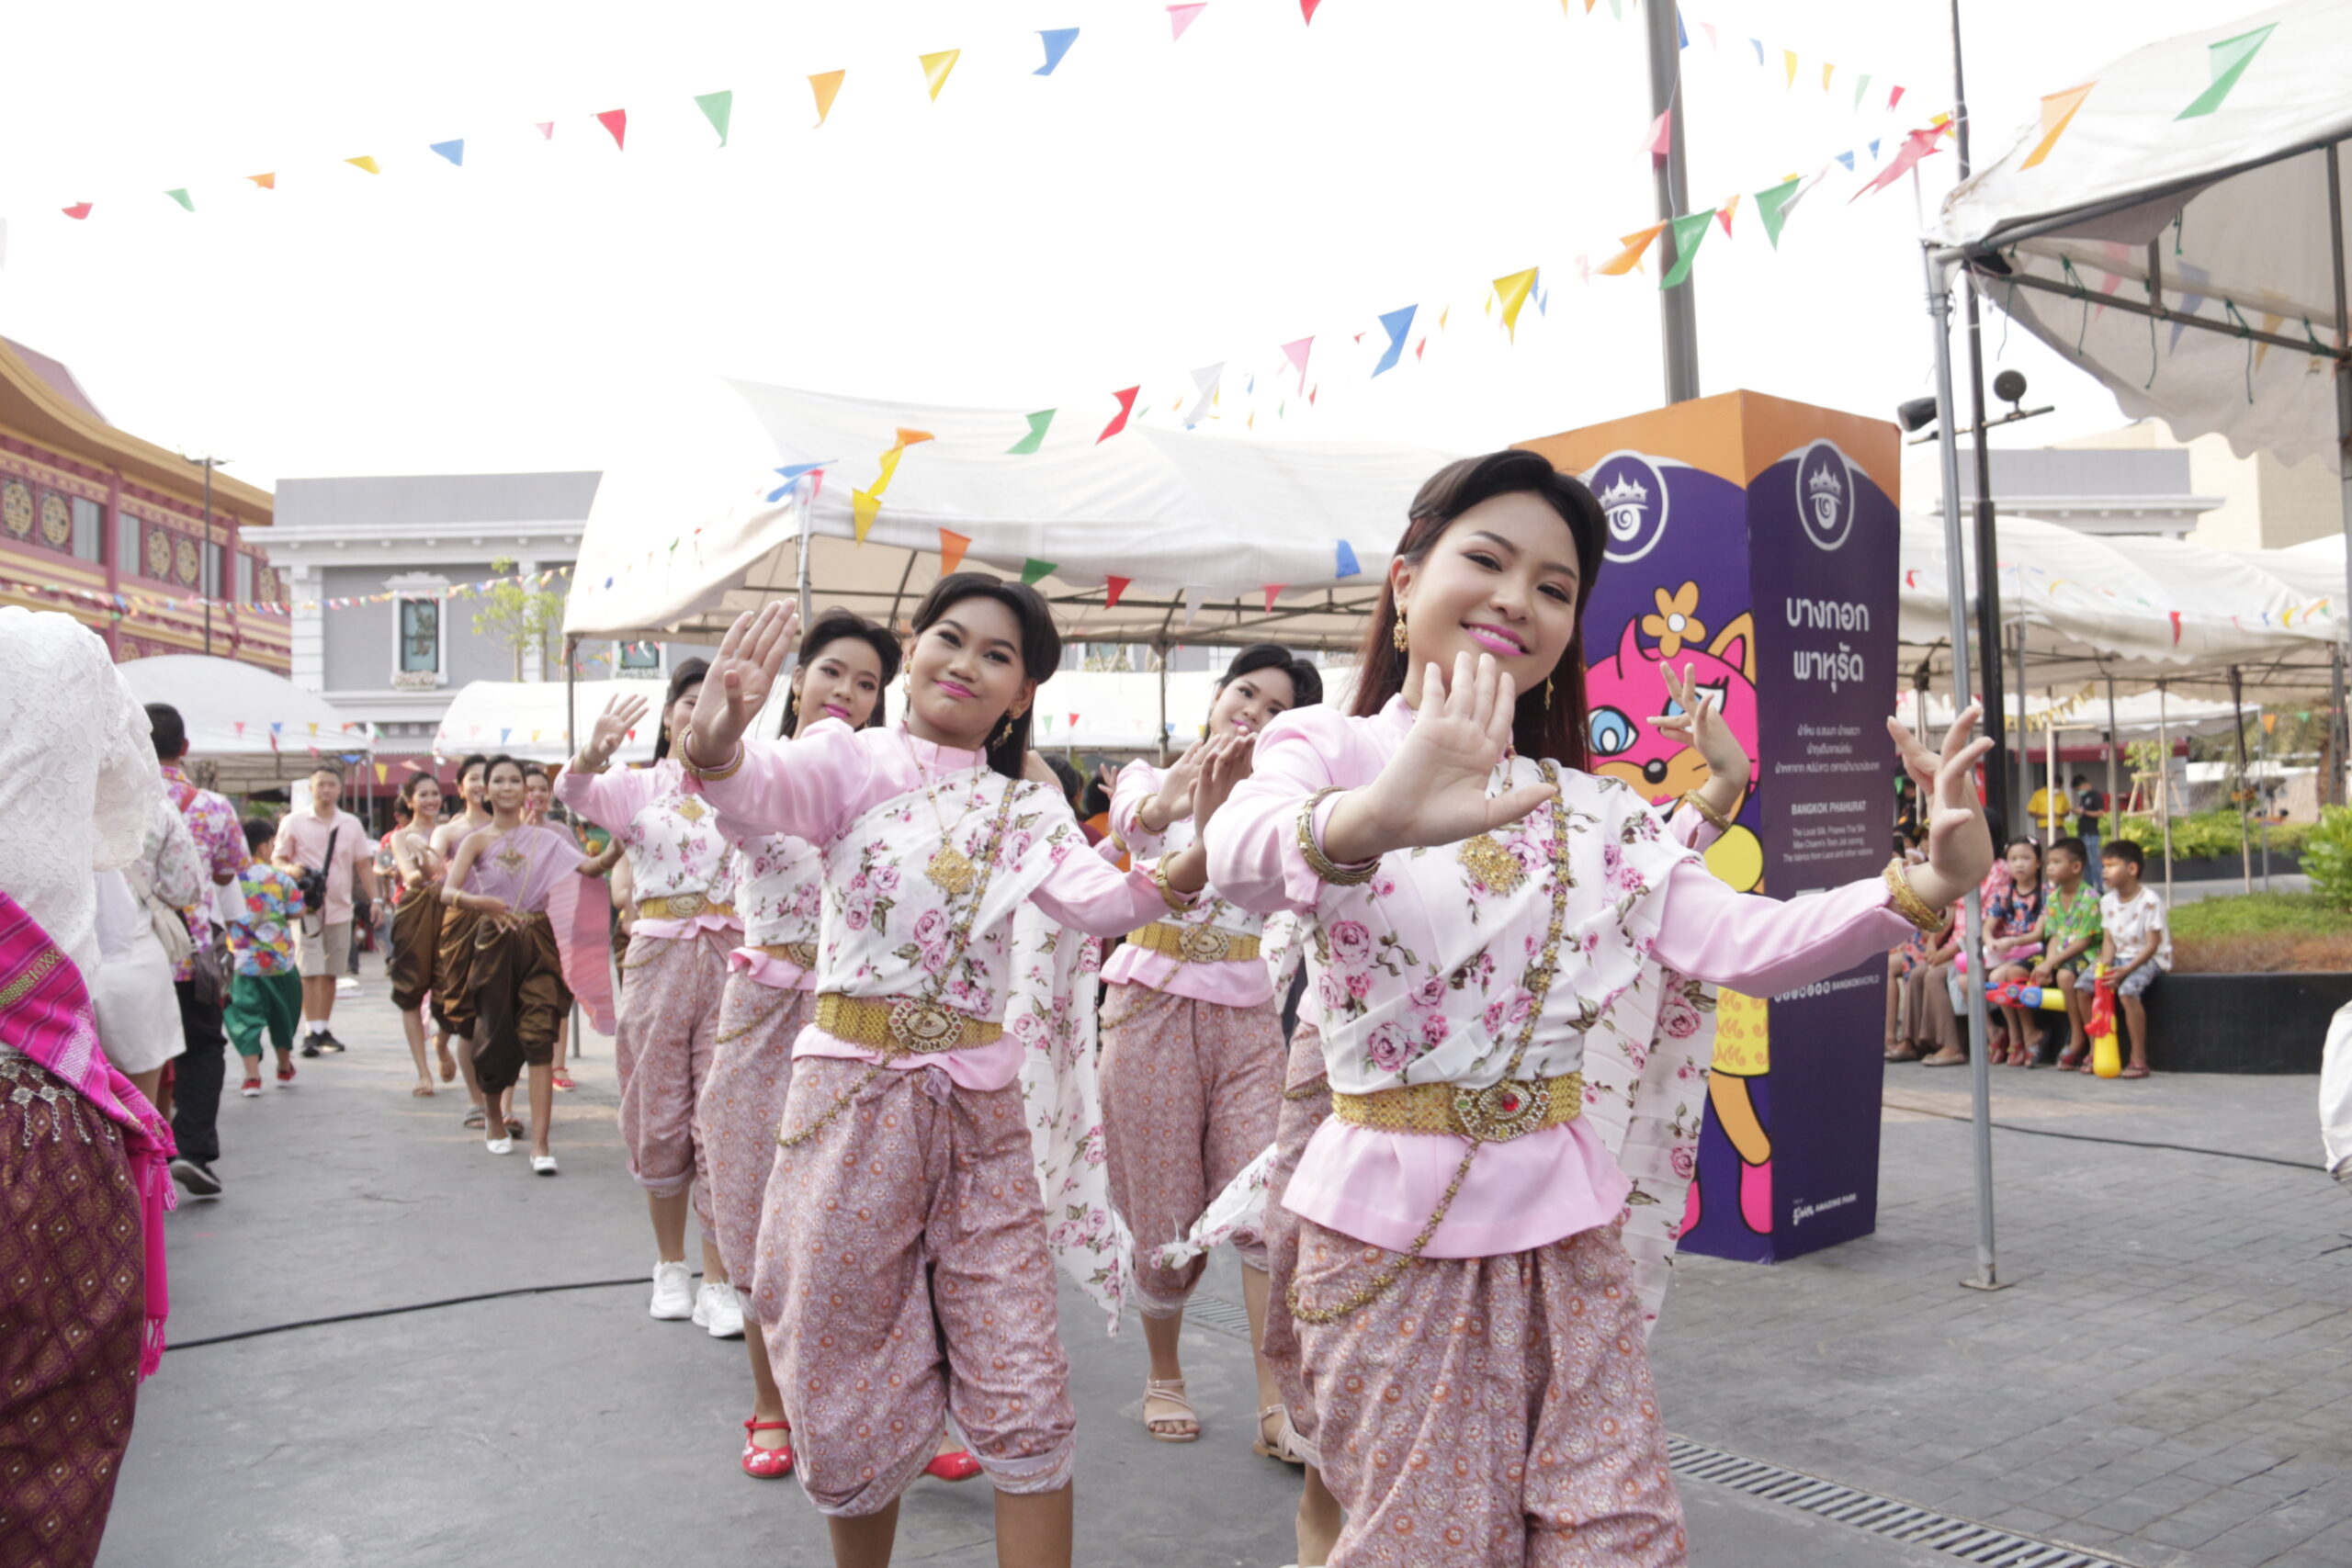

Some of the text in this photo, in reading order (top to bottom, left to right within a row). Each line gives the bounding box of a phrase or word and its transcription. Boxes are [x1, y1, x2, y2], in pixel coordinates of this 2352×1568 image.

[1786, 597, 1870, 632] บางกอก
[1793, 641, 1864, 693] พาหุรัด
[1791, 800, 1867, 816] BANGKOK PHAHURAT
